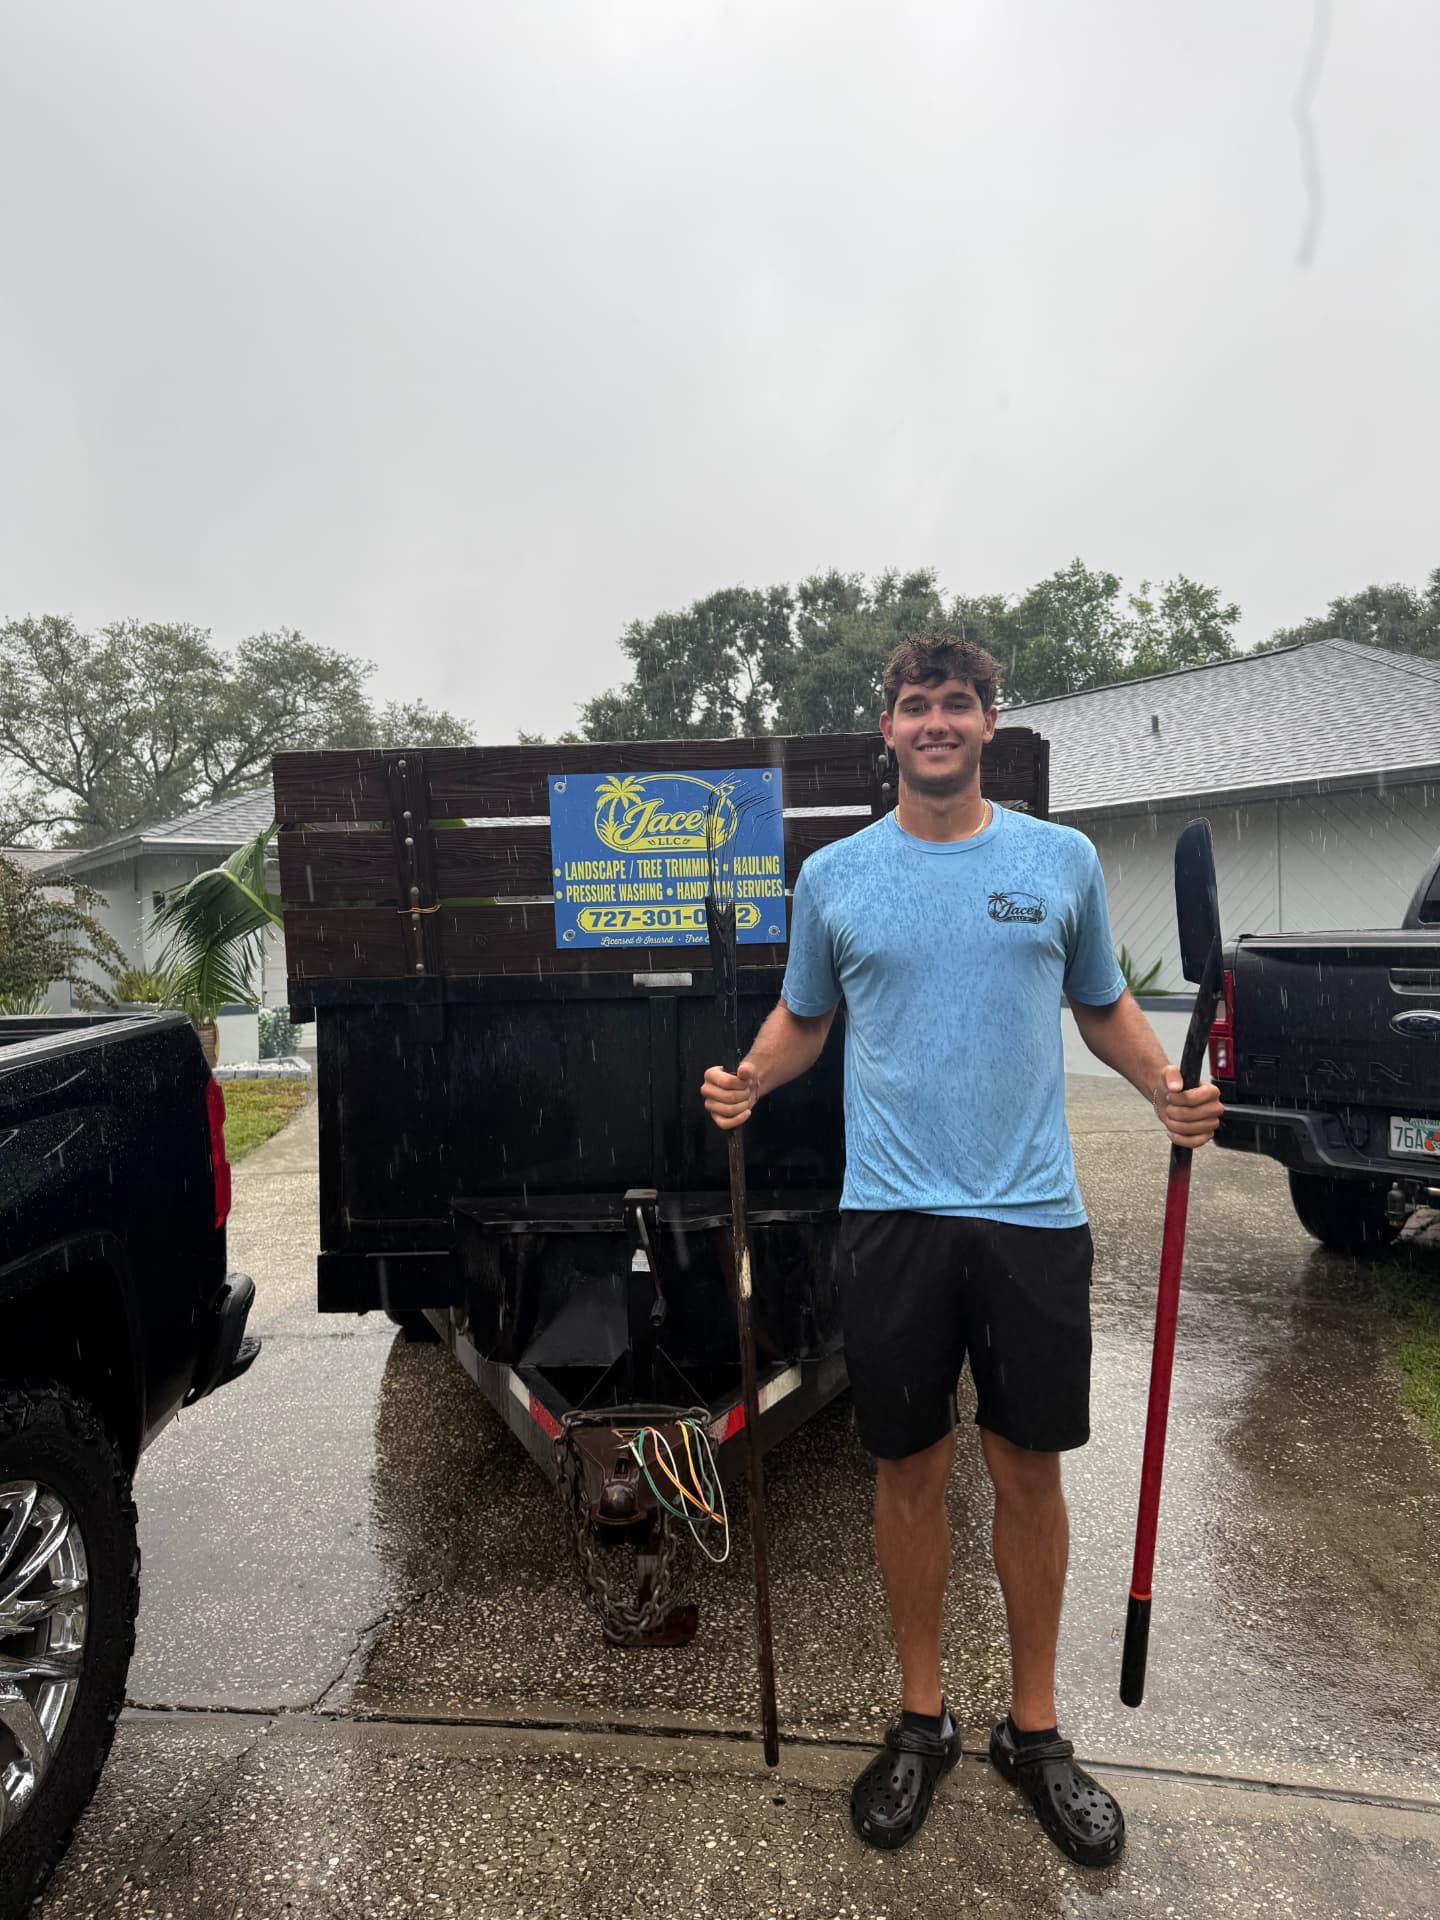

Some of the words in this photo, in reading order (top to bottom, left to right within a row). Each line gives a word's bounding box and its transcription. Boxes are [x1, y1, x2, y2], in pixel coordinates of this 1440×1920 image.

[613, 798, 703, 847] Jace
[658, 838, 681, 846] LLC
[564, 860, 626, 881] LANDSCAPE
[636, 858, 663, 878] TREE
[664, 857, 720, 878] TRIMMING
[733, 855, 780, 876] HAULING
[566, 884, 616, 903] PRESSURE
[618, 881, 663, 902] WASHING
[736, 878, 783, 898] SERVICES
[588, 907, 751, 928] 727-301-02
[997, 902, 1034, 919] Jace
[600, 936, 634, 947] Licensed
[635, 936, 642, 944] &
[643, 935, 674, 945] Insured
[685, 934, 704, 944] Free
[1393, 1126, 1424, 1150] 76A
